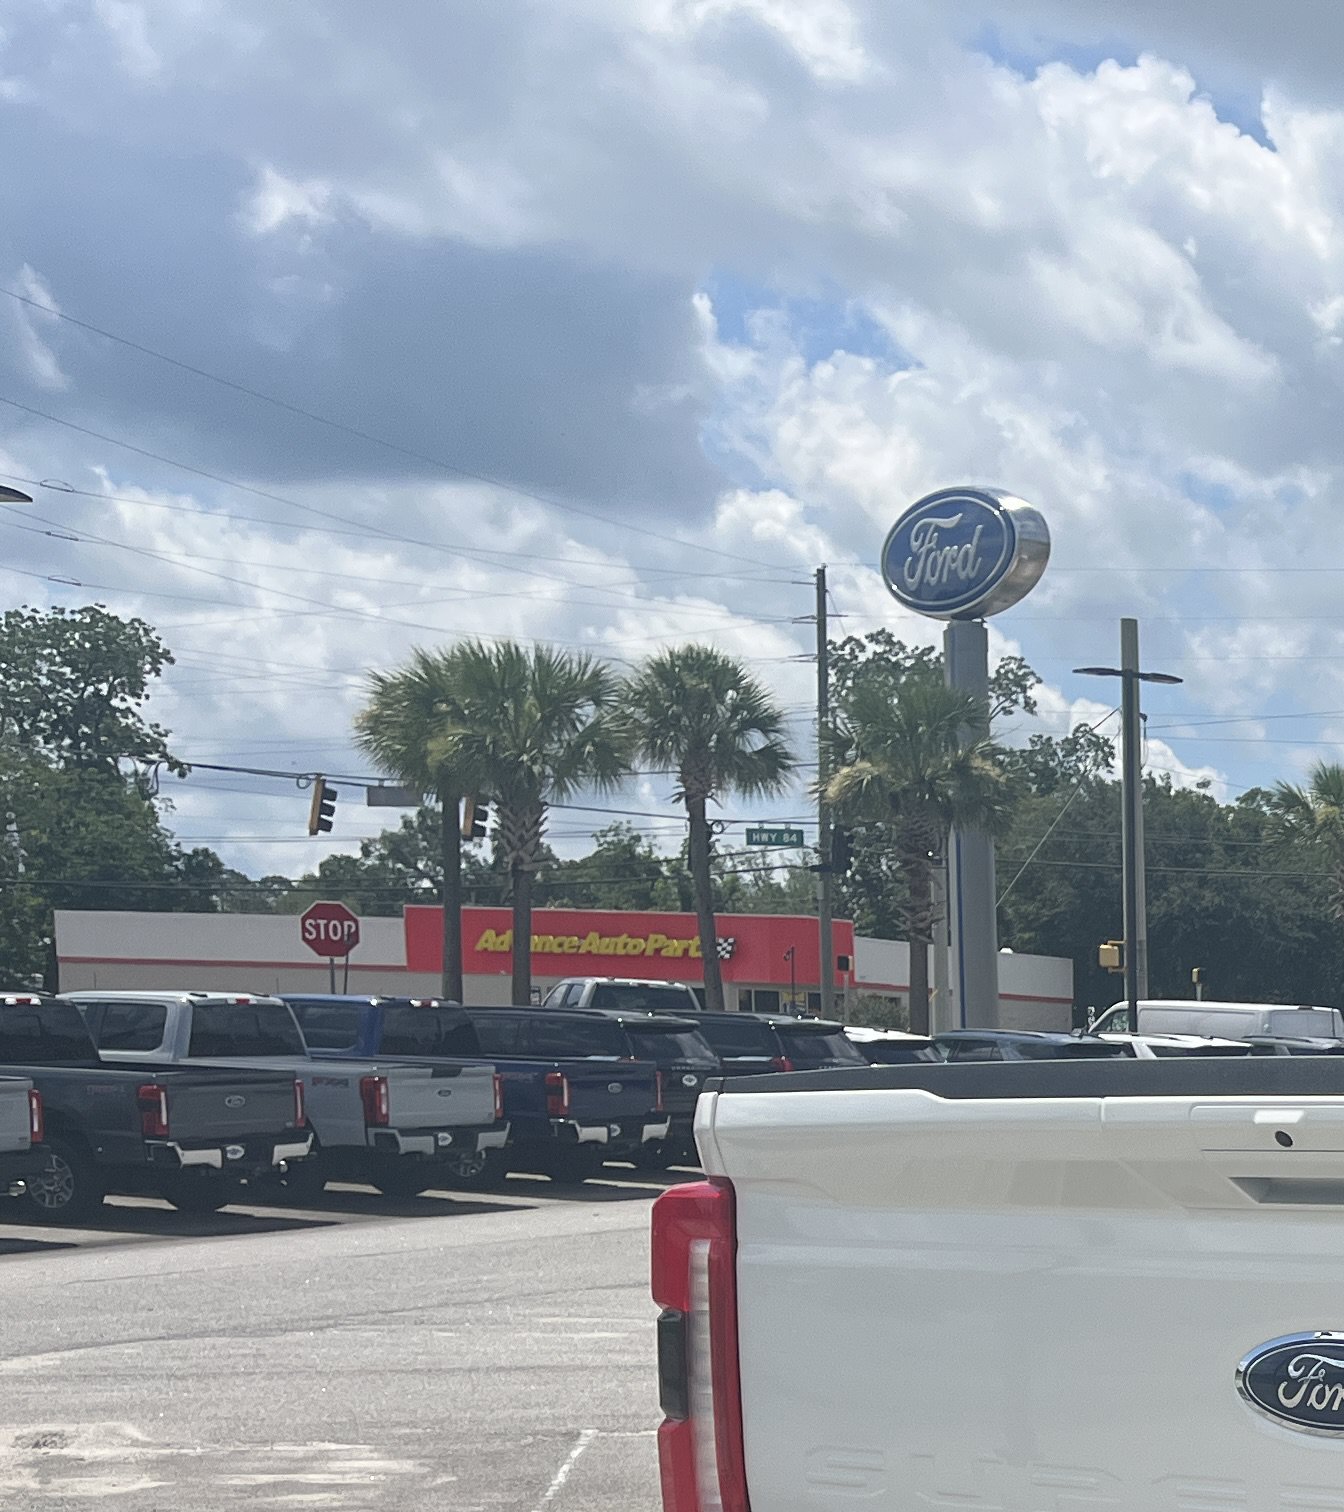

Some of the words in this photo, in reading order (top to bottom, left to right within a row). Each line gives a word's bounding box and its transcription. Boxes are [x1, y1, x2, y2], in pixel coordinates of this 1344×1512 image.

[903, 513, 984, 591] Ford
[752, 832, 778, 842] HWY
[782, 833, 798, 843] 84
[305, 919, 357, 941] STOP
[474, 929, 579, 953] Adnce
[577, 931, 646, 955] Auto
[644, 933, 703, 958] Part
